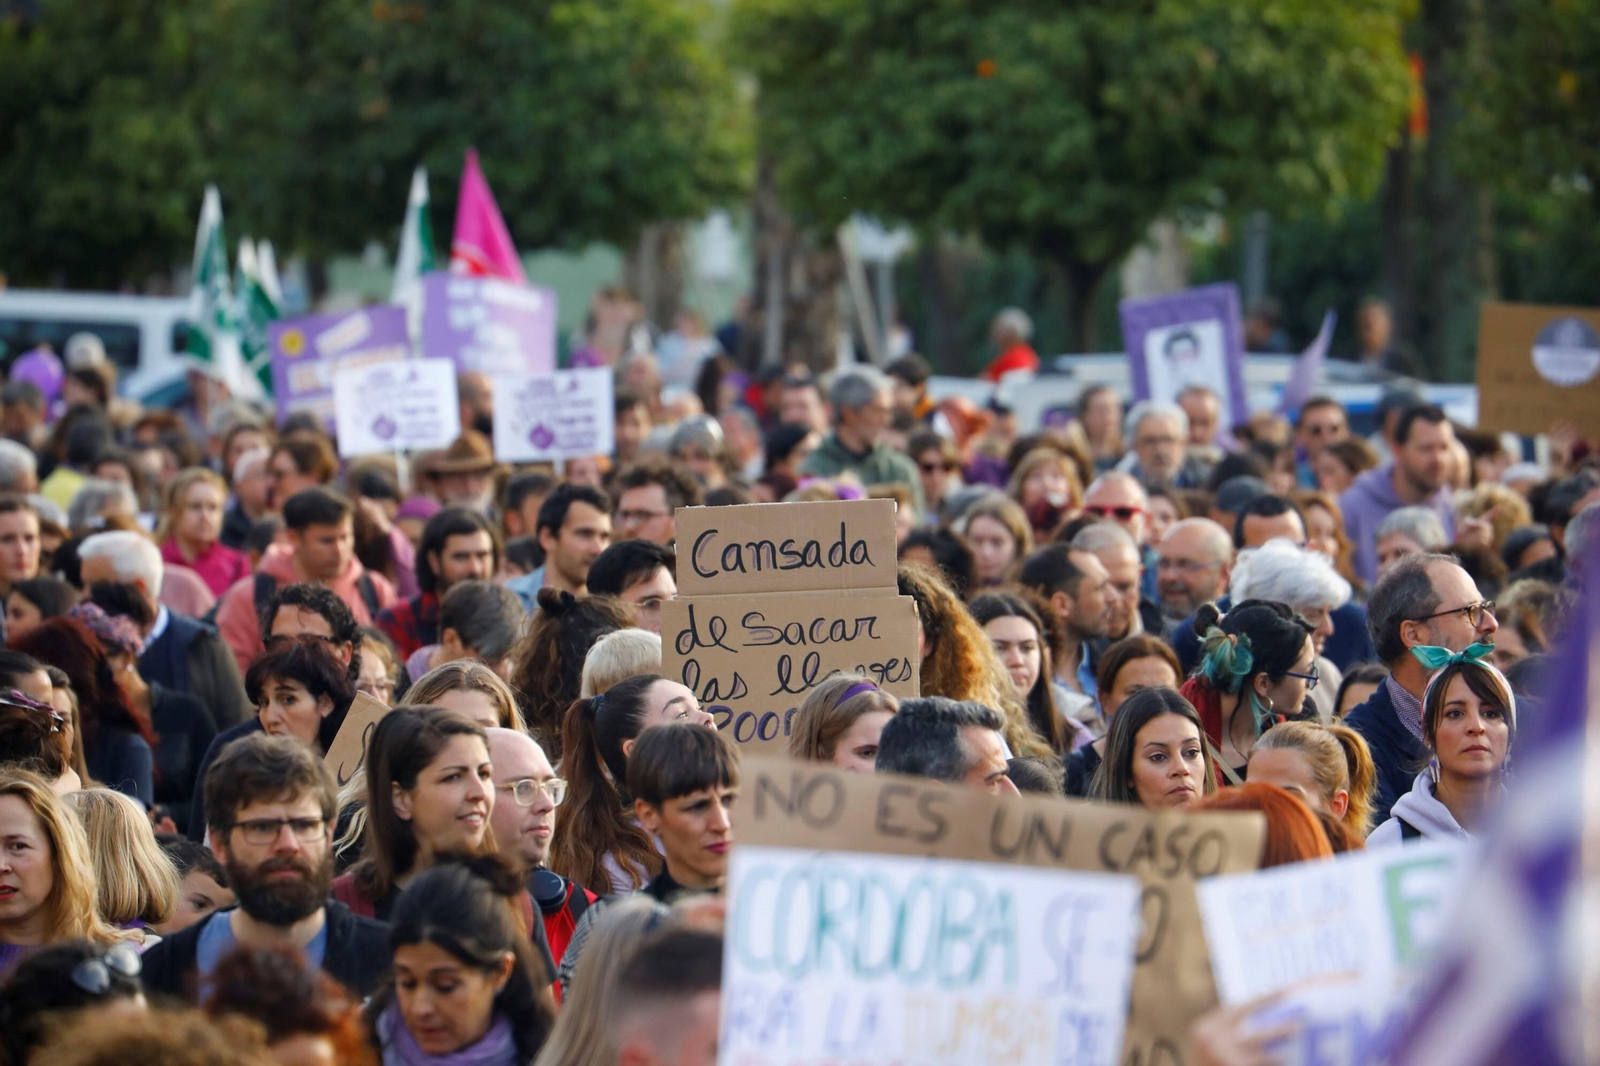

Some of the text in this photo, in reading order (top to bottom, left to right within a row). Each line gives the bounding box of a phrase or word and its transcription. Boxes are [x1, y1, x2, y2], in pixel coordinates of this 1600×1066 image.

[692, 522, 876, 578] Cansada
[675, 604, 738, 655] de
[682, 658, 748, 703] las
[753, 772, 1230, 879] NO ES UN CASO
